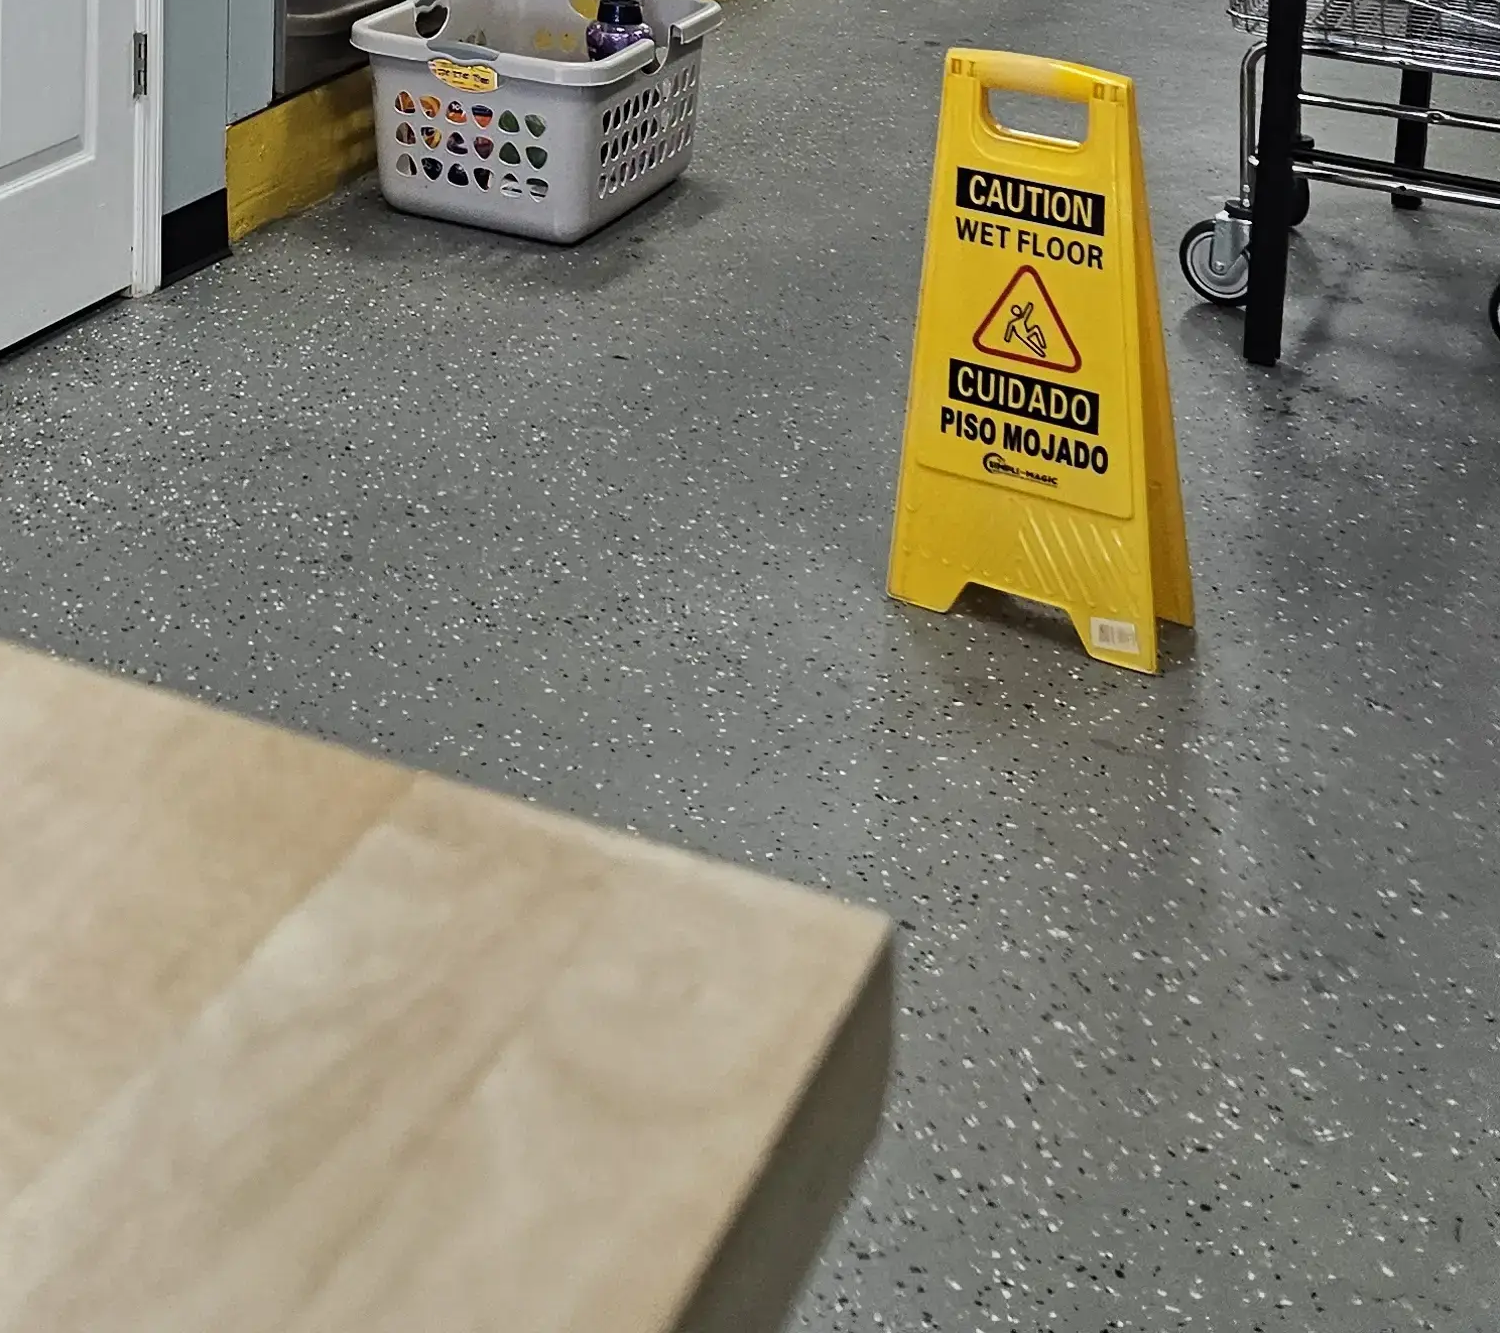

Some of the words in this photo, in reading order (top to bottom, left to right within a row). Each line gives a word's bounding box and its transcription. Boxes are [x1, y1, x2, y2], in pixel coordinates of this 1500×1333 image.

[969, 175, 1093, 228] CAUTION
[955, 216, 1011, 249] WET
[1017, 229, 1103, 270] FLOOR
[957, 366, 1091, 426] CUIDADO
[941, 405, 996, 445] PISO
[1003, 422, 1109, 475] MOJADO
